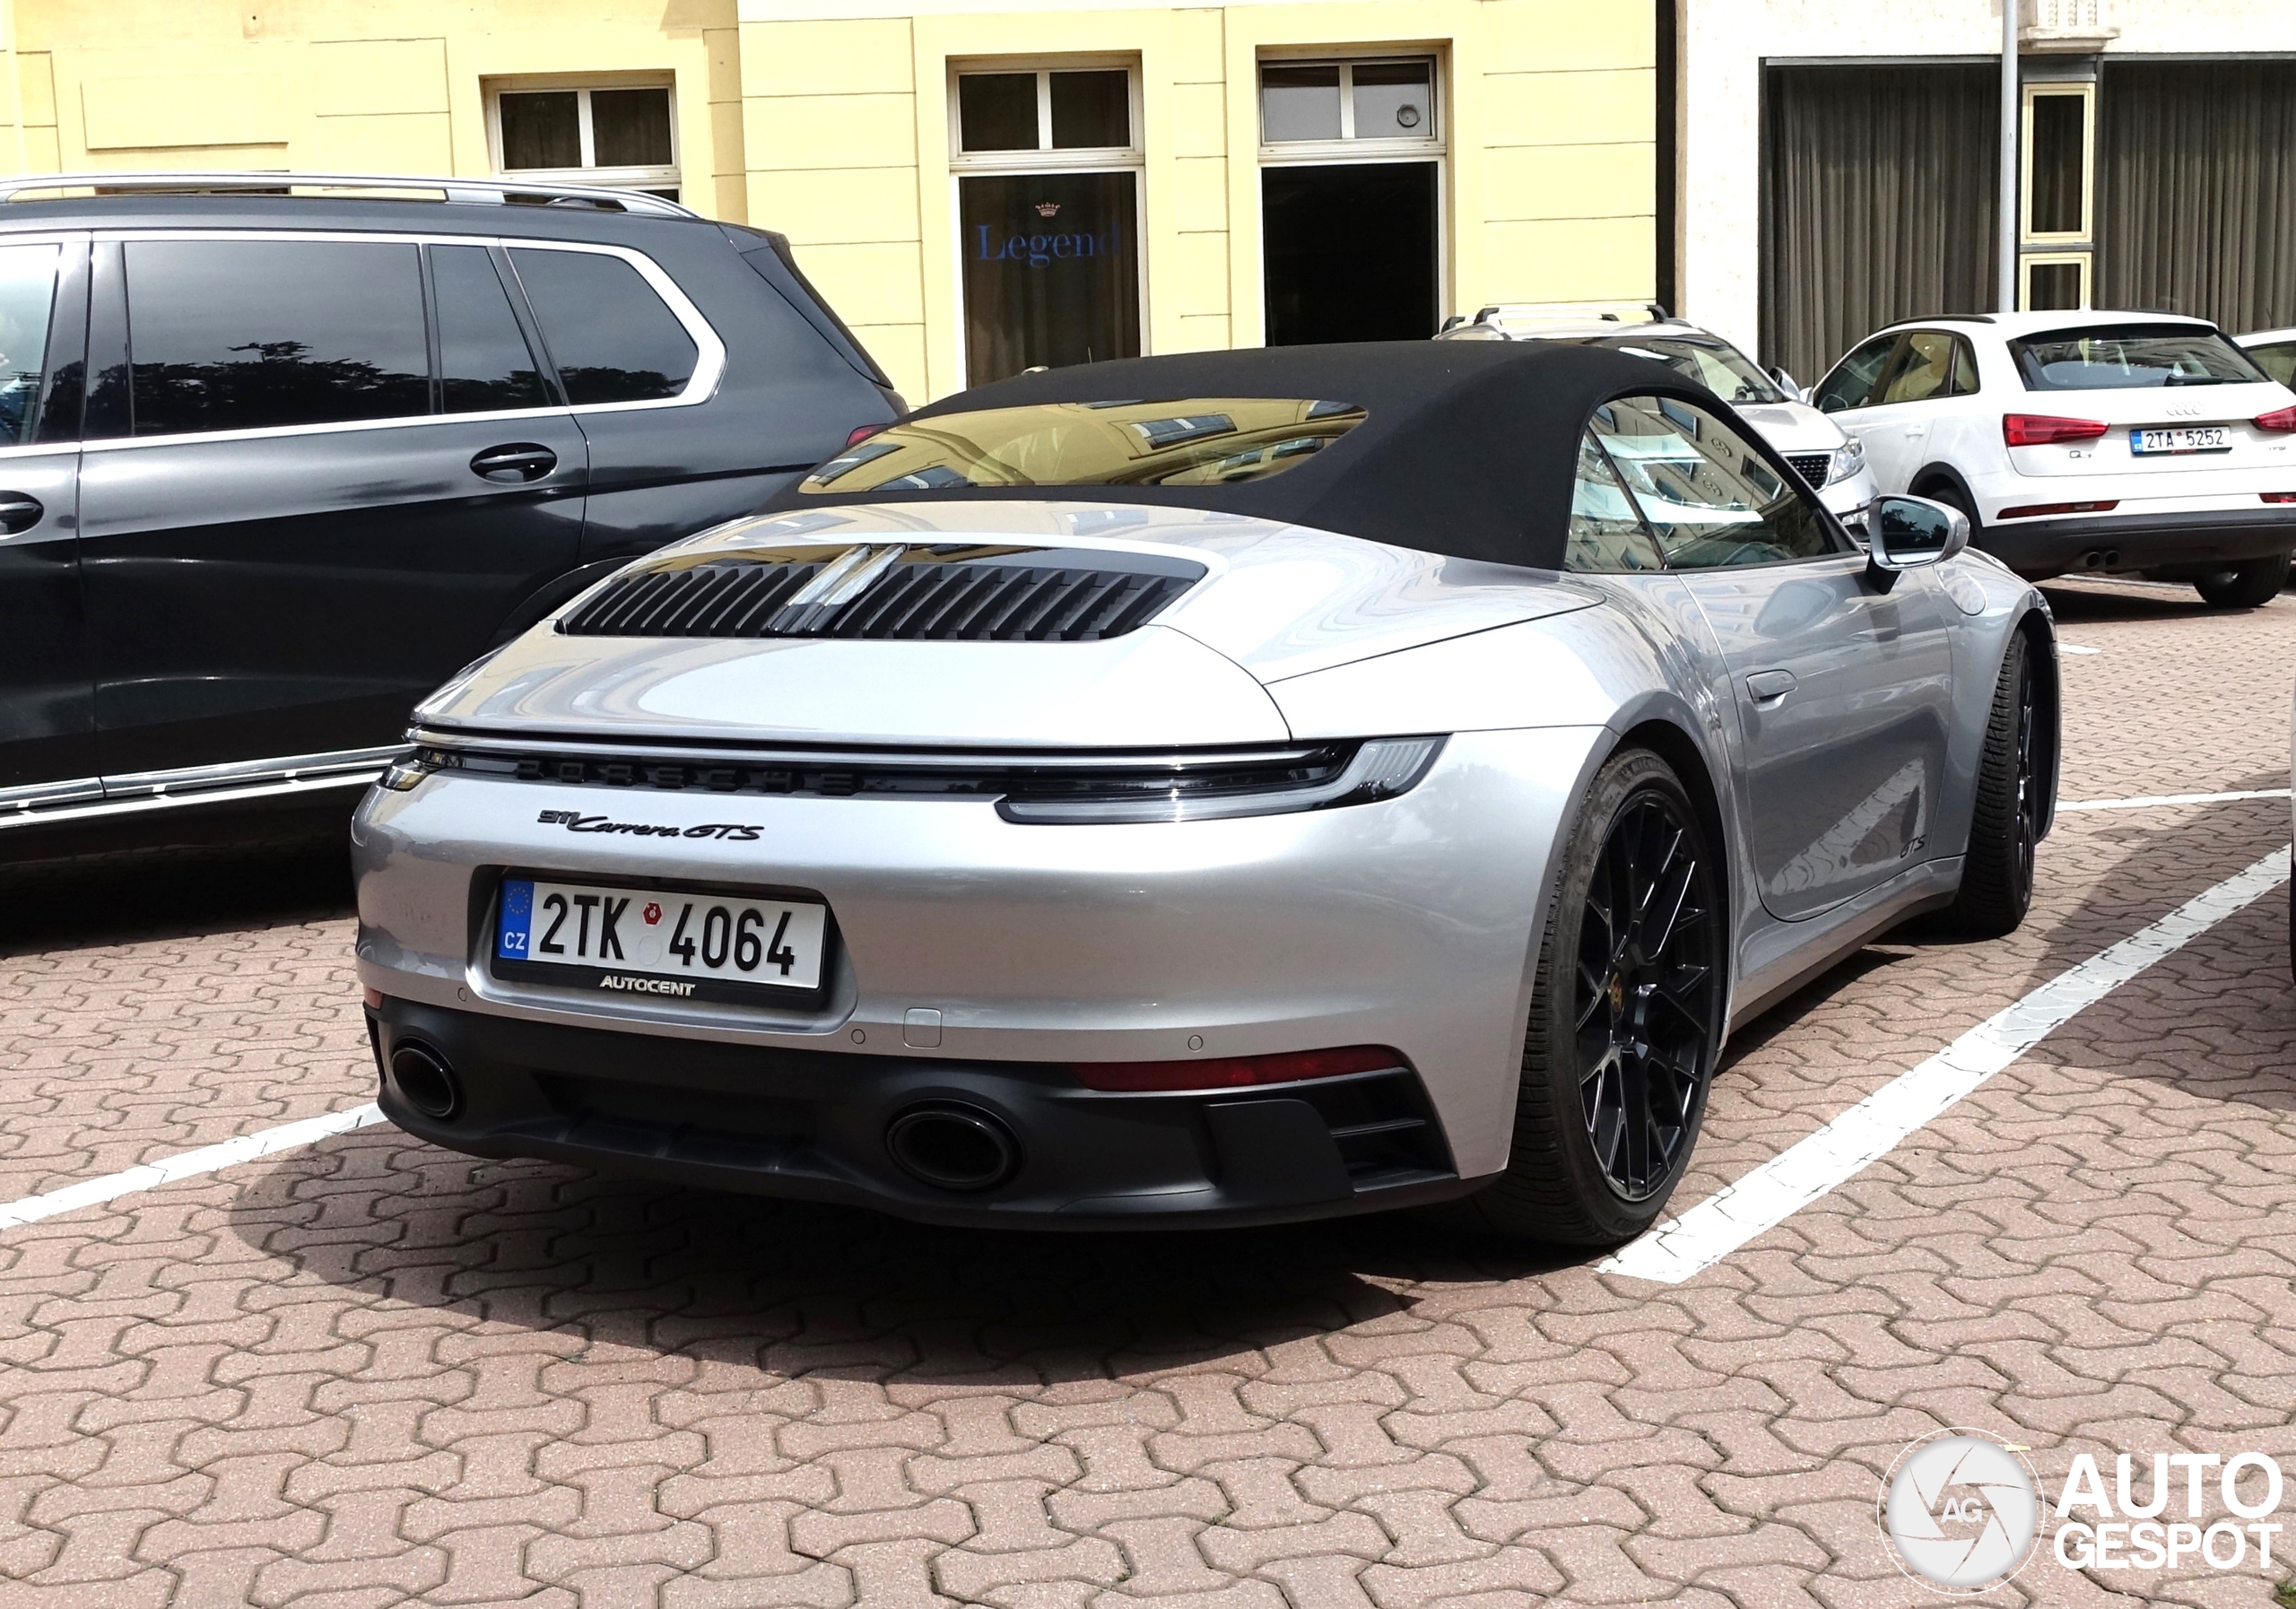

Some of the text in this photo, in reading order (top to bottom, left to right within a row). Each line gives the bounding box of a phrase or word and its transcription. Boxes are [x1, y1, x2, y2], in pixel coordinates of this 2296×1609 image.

[977, 222, 1121, 268] Legend
[2145, 430, 2223, 448] 2TA 5252
[516, 759, 854, 795] PORSCHE
[537, 809, 765, 840] 911 Carrera GTS
[1900, 834, 1927, 858] GTS
[504, 931, 526, 951] CZ
[539, 893, 795, 976] 2TK 4064
[600, 975, 696, 997] AUTOCENT
